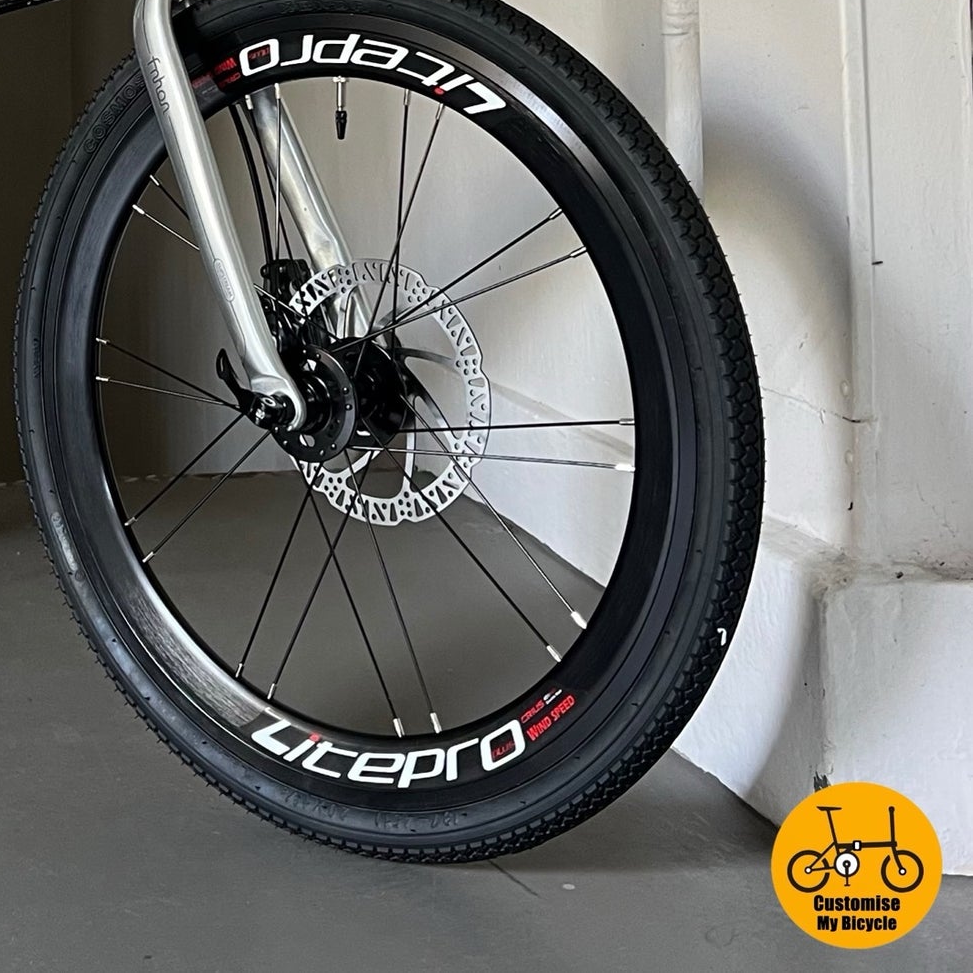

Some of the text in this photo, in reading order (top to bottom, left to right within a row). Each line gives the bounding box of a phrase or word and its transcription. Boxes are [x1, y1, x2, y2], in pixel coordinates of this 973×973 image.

[147, 56, 171, 114] fnhon
[239, 33, 507, 115] Litepro
[550, 695, 575, 721] SPEED
[251, 707, 526, 788] Litepro
